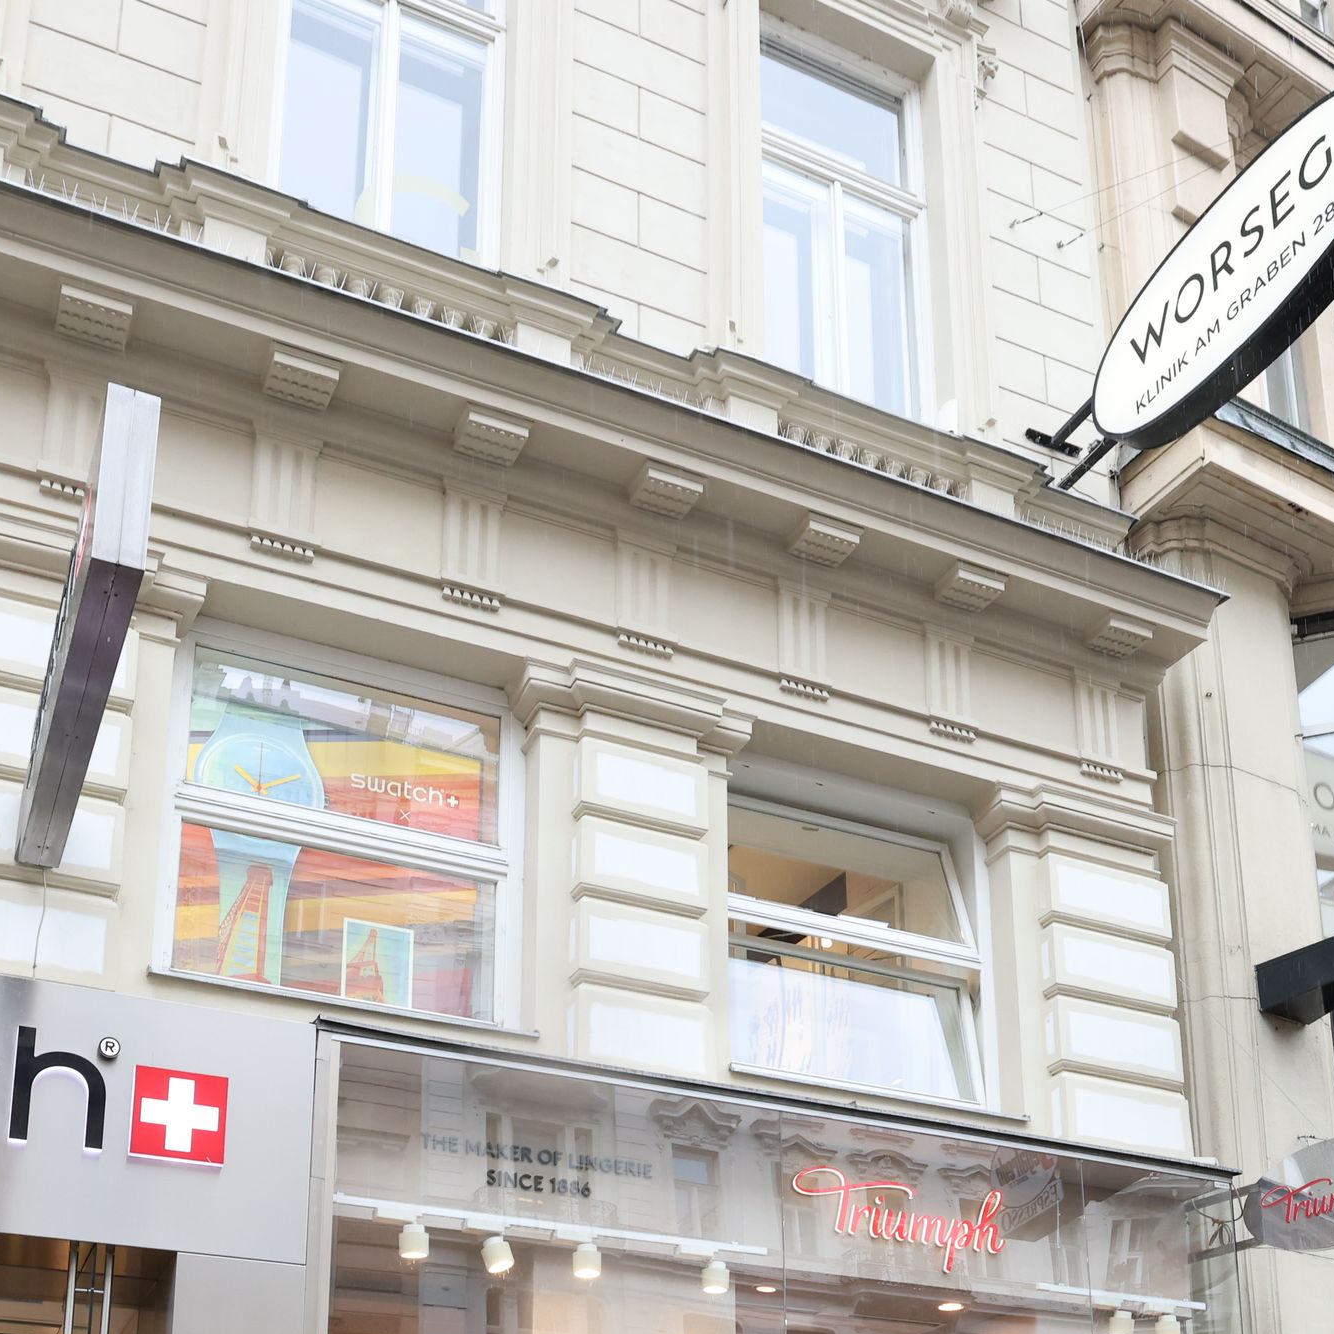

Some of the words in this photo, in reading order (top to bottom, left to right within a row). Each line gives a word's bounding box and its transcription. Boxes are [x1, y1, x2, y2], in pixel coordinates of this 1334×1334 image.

[1129, 134, 1333, 364] WORSEG
[1136, 350, 1189, 415] KLINIK
[1194, 319, 1222, 356] AM
[1227, 231, 1306, 320] GRABEN
[351, 773, 445, 807] swatch
[422, 1132, 459, 1153] THE
[465, 1139, 533, 1163] MAKER
[537, 1148, 563, 1167] OF
[568, 1153, 654, 1179] LINGERIE
[486, 1169, 544, 1192] SINCE
[550, 1176, 592, 1198] 1886
[792, 1165, 1006, 1273] Triumph
